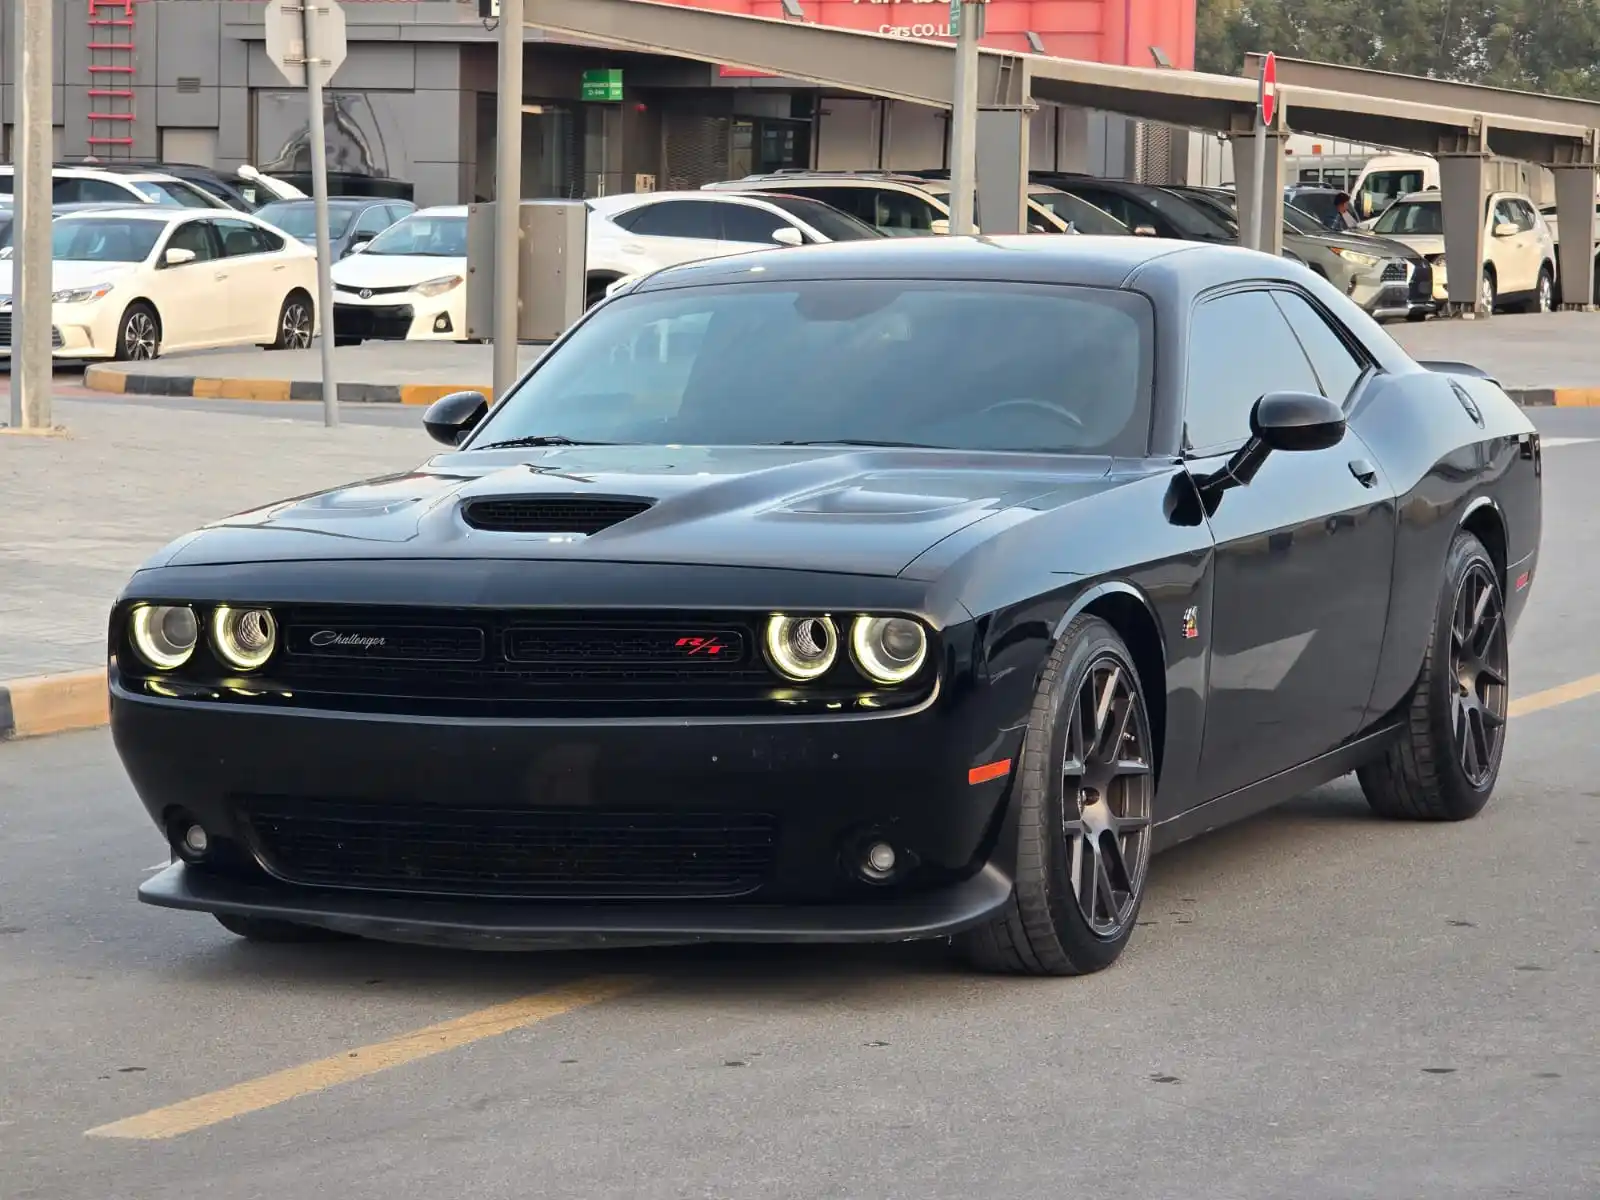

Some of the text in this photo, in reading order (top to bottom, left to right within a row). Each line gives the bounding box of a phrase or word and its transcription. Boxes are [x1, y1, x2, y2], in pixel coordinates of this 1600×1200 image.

[879, 24, 910, 37] Cars
[309, 630, 386, 650] Challenger
[675, 637, 729, 655] R/T
